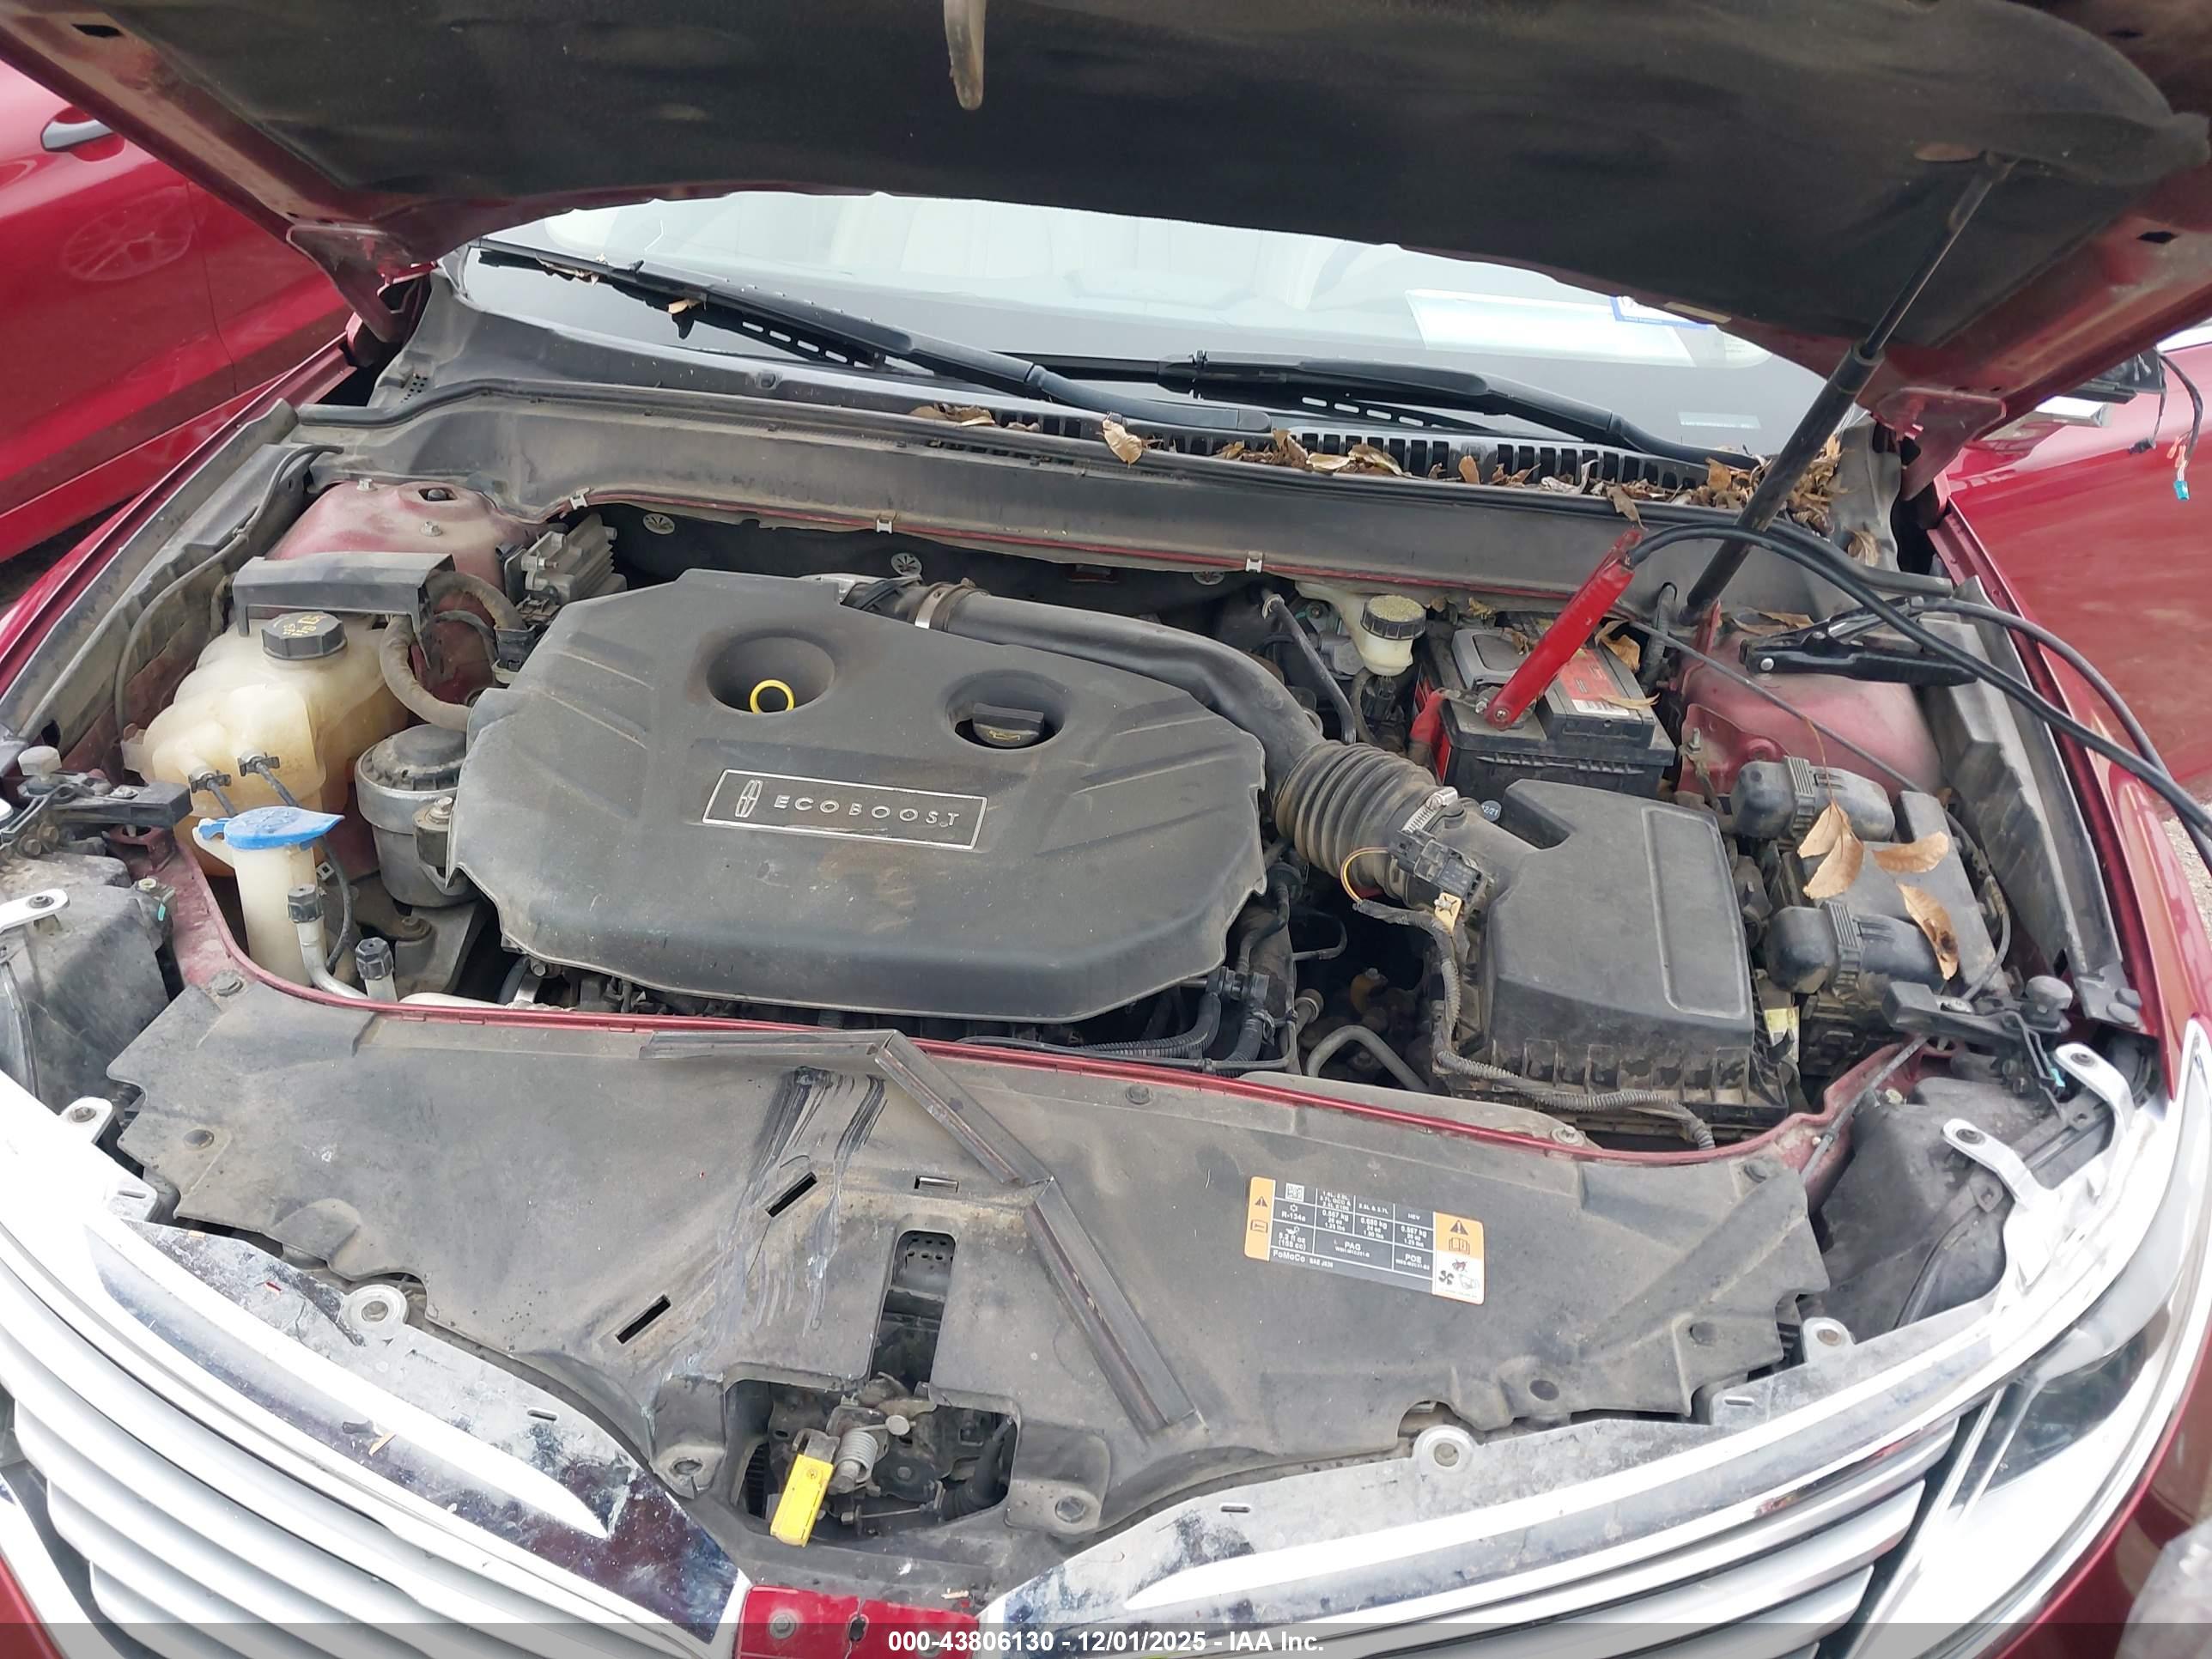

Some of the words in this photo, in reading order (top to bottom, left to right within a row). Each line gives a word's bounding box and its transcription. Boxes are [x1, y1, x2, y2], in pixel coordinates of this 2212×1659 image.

[774, 795, 959, 827] ECOBOOST
[1281, 1210, 1306, 1222] R-134a
[1340, 1212, 1349, 1222] kg
[1379, 1220, 1388, 1230] kg
[1419, 1229, 1427, 1238] kg
[1273, 1249, 1305, 1262] FoMoCo
